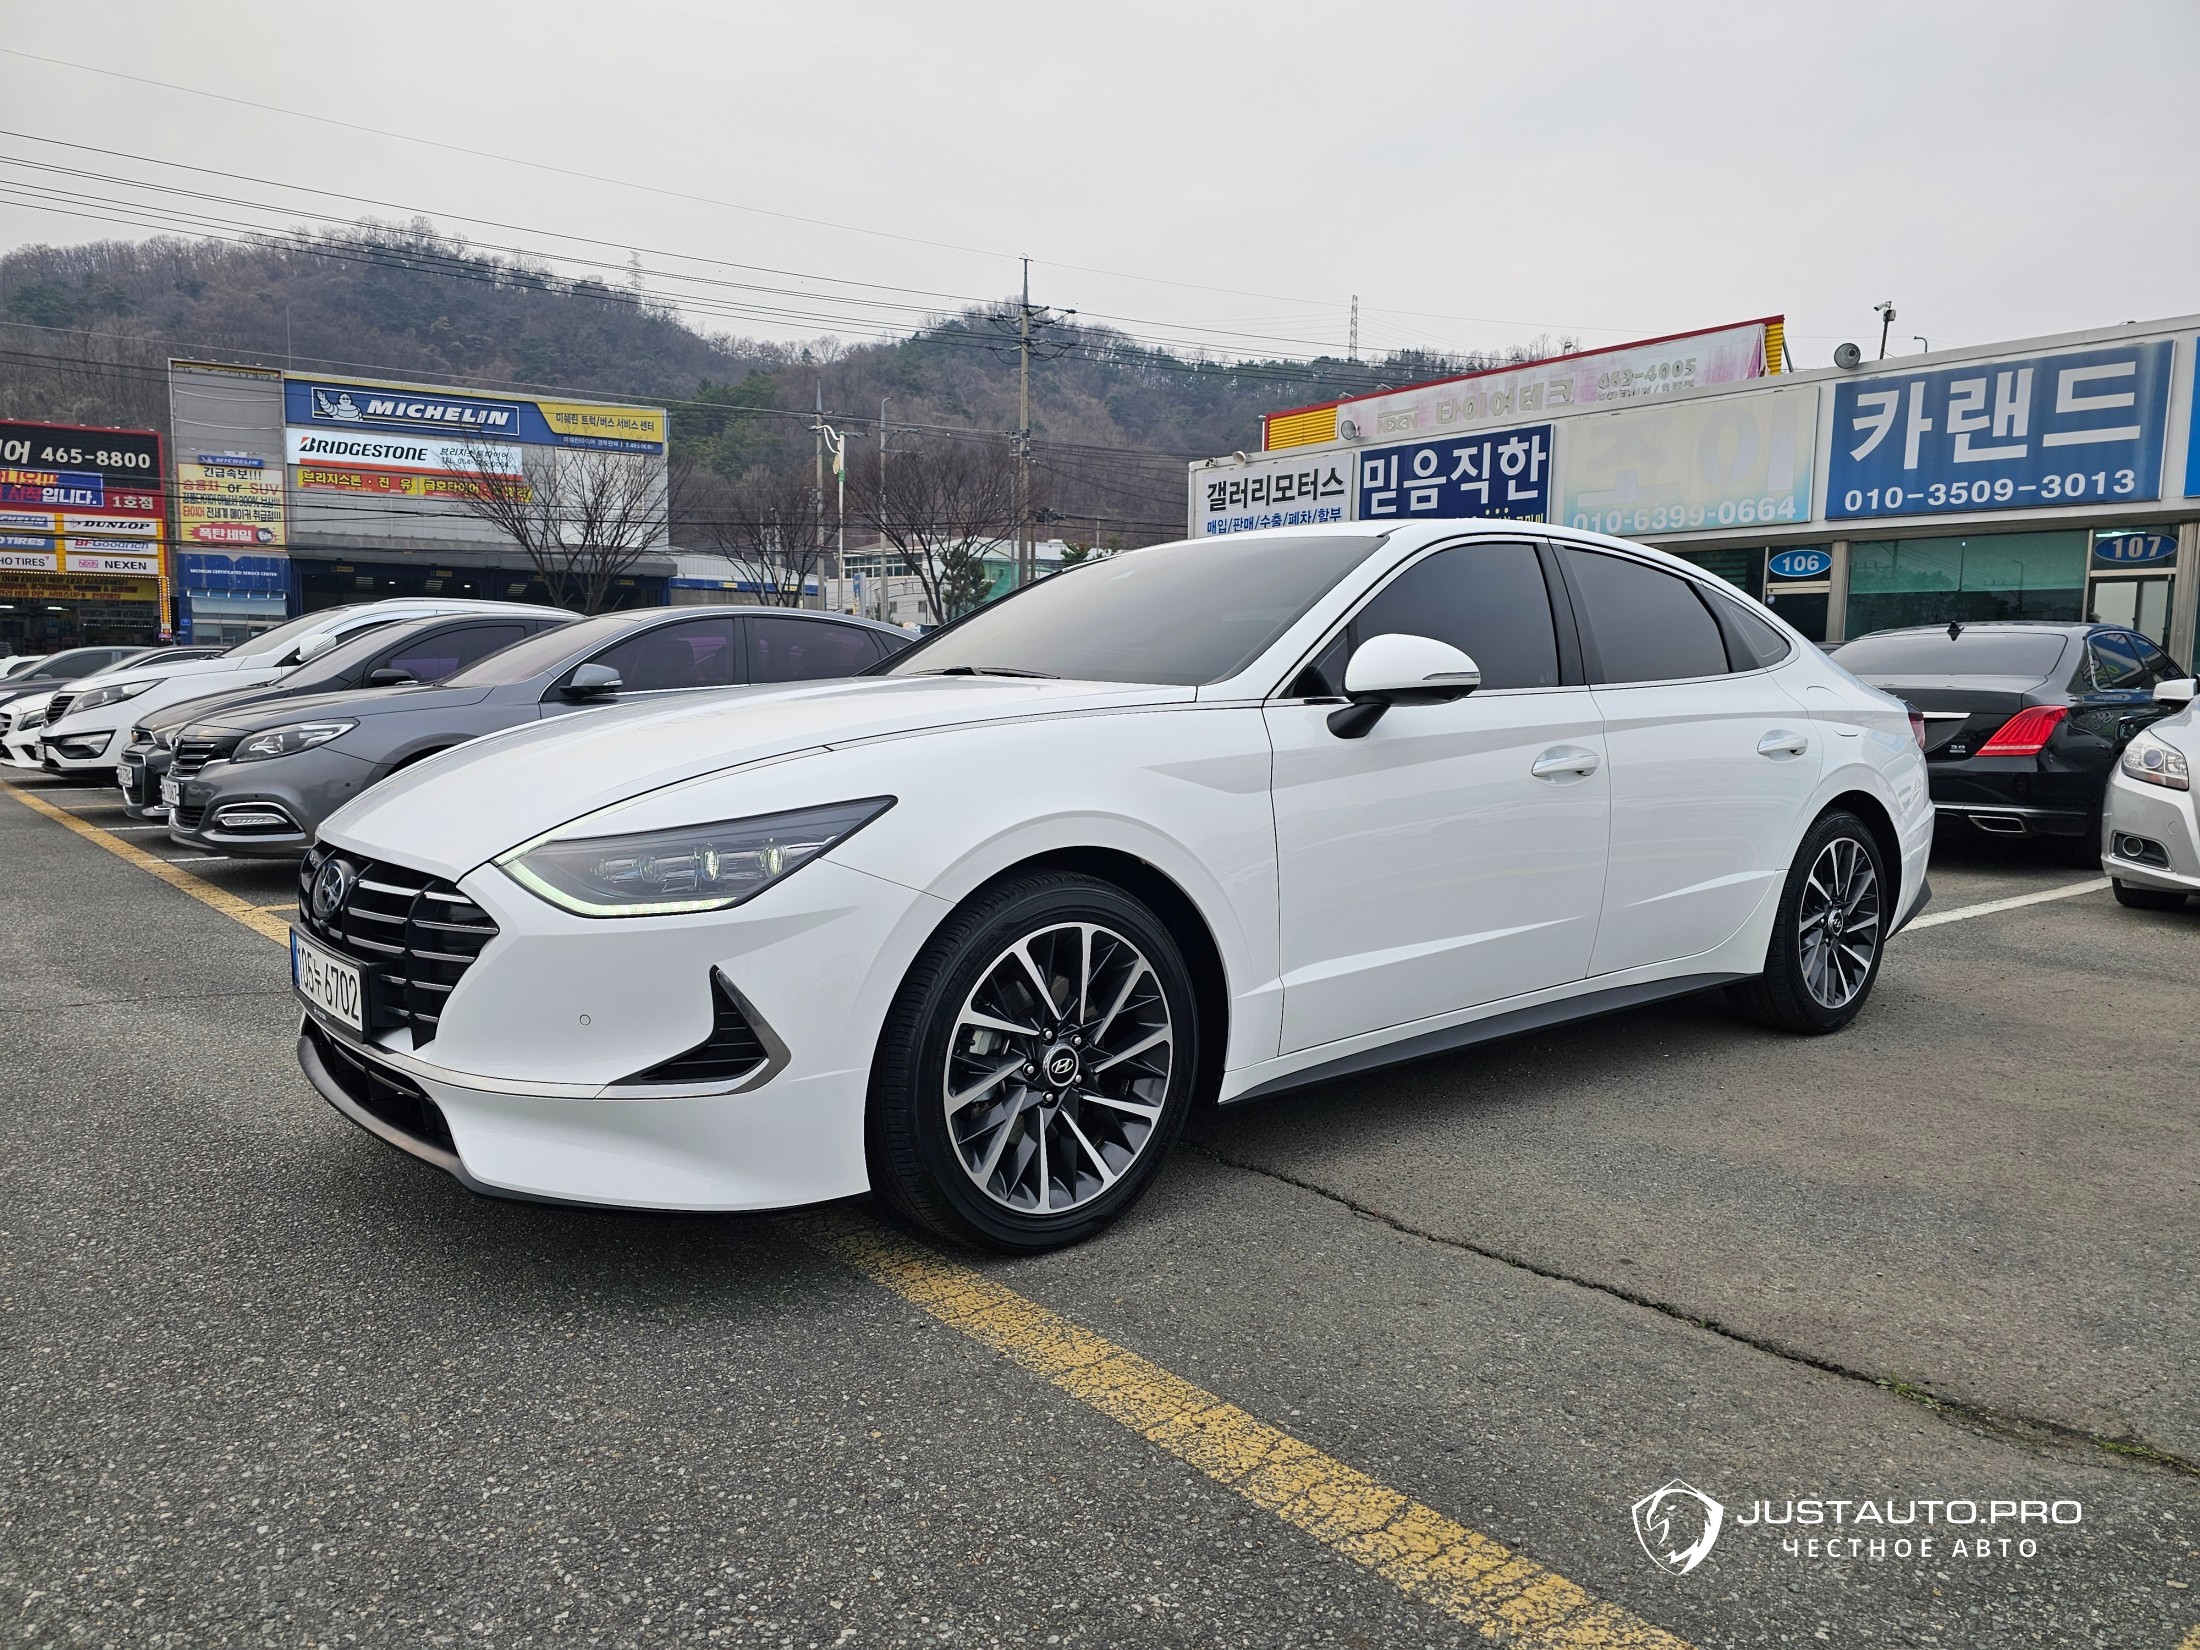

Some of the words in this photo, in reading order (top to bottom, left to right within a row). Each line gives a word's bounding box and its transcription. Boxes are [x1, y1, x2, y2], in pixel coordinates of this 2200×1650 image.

[1436, 377, 1574, 425] 타이어테크
[367, 400, 509, 425] MICHELIN
[1849, 361, 2141, 470] 카랜드
[556, 413, 578, 425] 미쉐린
[581, 415, 615, 427] 트럭/버스
[617, 418, 638, 430] 서비스
[640, 420, 654, 432] 센터
[0, 439, 31, 464] 어
[41, 446, 150, 469] 465-8800
[299, 437, 428, 461] BRIDGESTONE
[215, 458, 259, 466] MICHELIN
[204, 467, 262, 480] 긴급속보!!!
[303, 471, 361, 486] 브리지스톤
[1363, 435, 1547, 515] 믿음직한
[228, 484, 242, 493] or
[250, 483, 278, 496] SUV
[425, 479, 479, 493] 금호타이어
[1207, 467, 1345, 512] 갤러리모터스
[1844, 469, 2136, 512] 010-3509-3013
[112, 496, 153, 510] 1호점
[183, 506, 205, 517] 타이어
[1207, 507, 1342, 534] 매입/판매/수출/폐차/할부
[1572, 494, 1796, 534] 010-6399-0664
[84, 521, 150, 530] DUNLOP
[199, 527, 252, 541] 폭탄세일
[7, 537, 46, 546] TIRES
[75, 538, 149, 550] BFGoodrich
[2112, 535, 2161, 560] 107
[15, 558, 45, 567] TIRES
[105, 561, 147, 570] NEXEN
[1782, 554, 1820, 572] 106
[325, 962, 360, 1022] 6702
